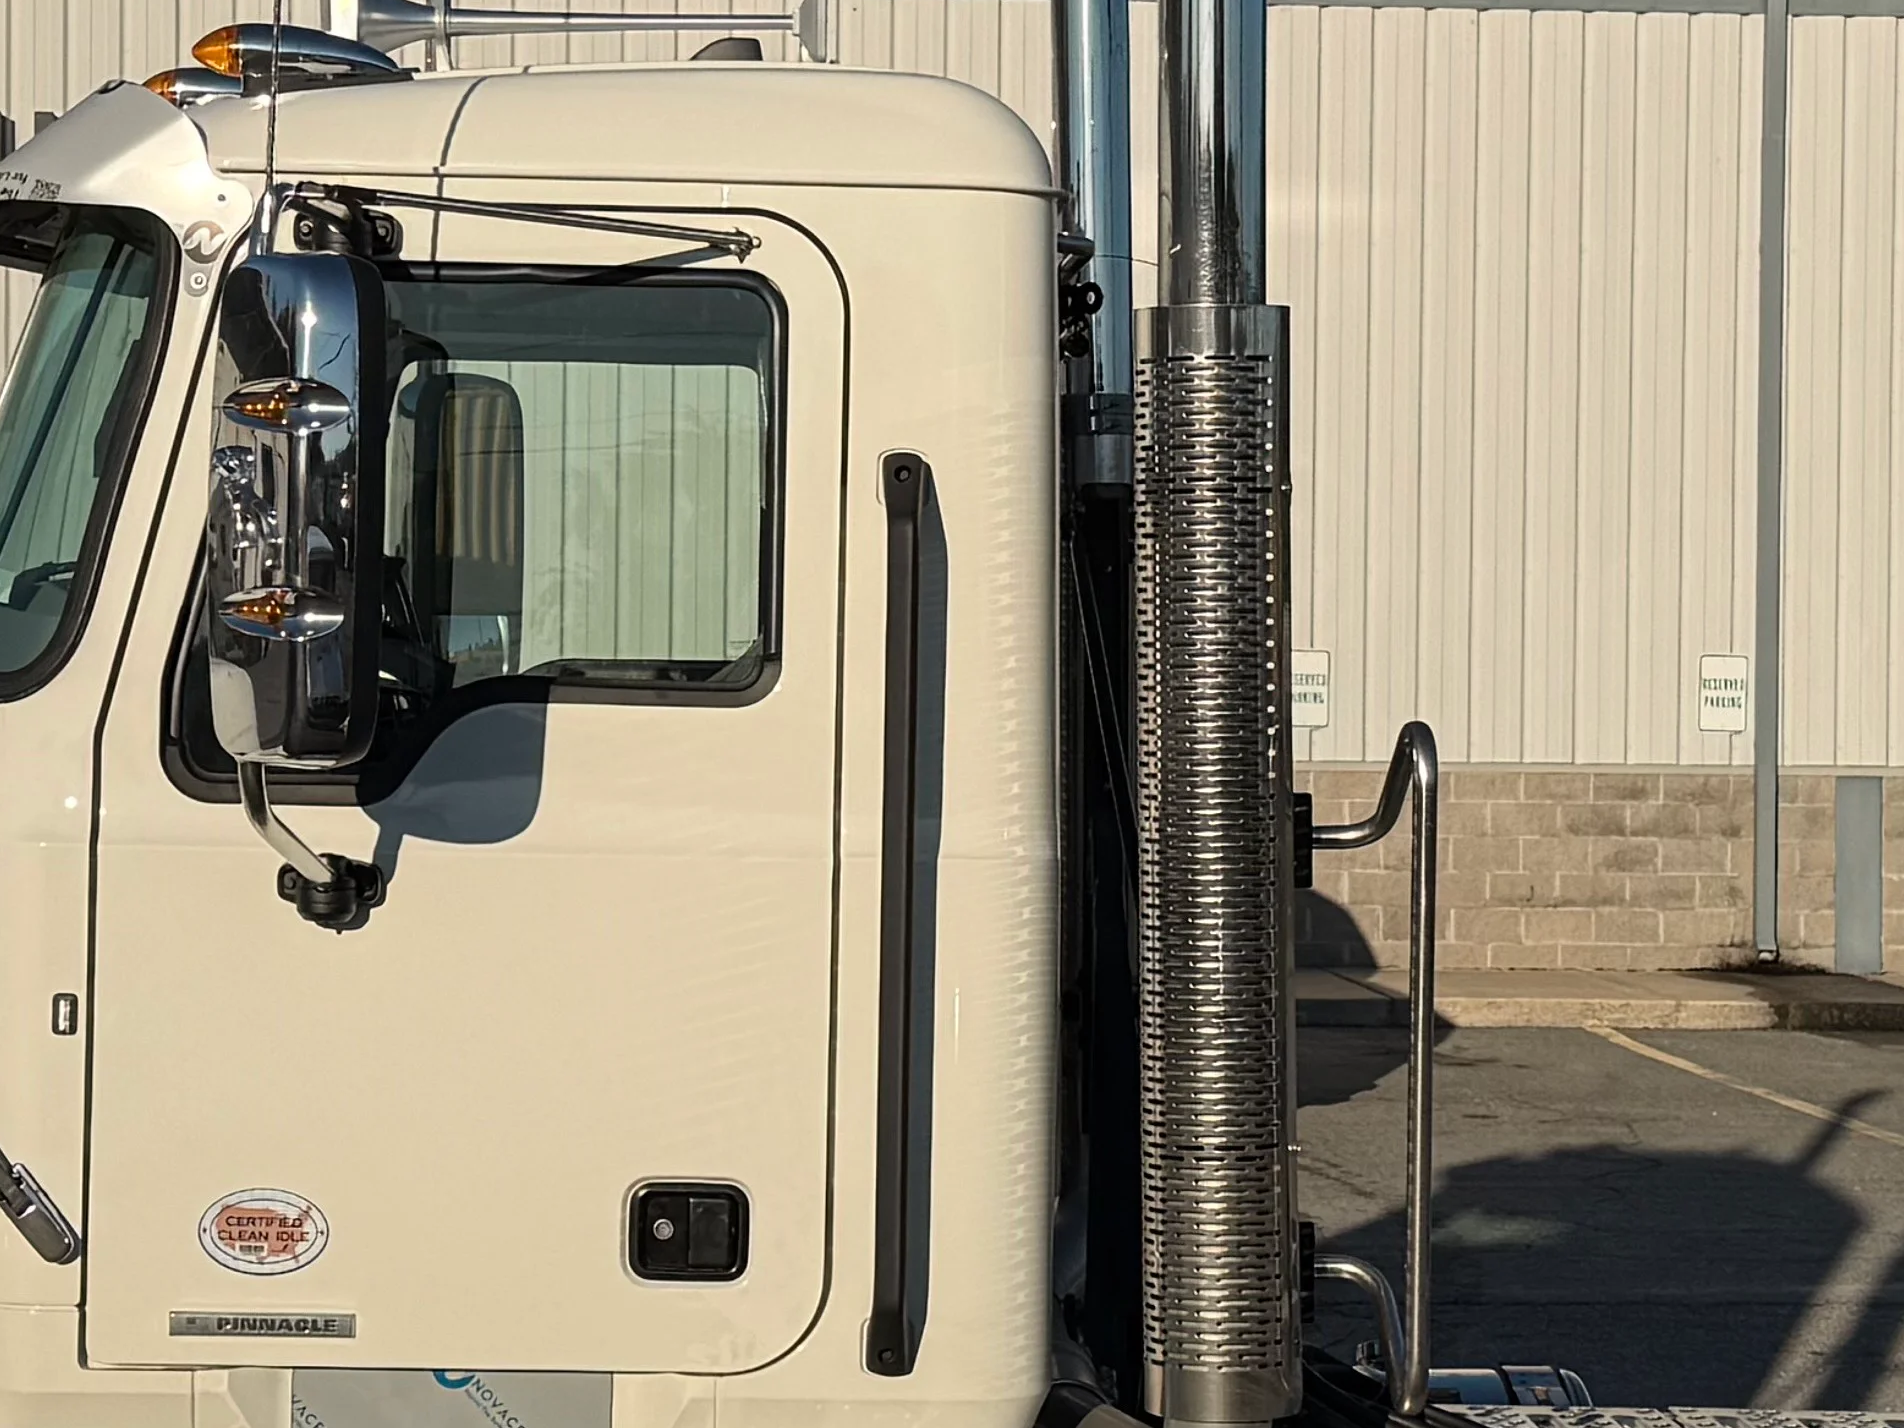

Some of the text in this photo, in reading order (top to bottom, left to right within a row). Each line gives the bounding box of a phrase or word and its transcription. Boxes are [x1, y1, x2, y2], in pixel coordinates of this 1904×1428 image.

[225, 1215, 303, 1228] CERTIFIED
[217, 1230, 310, 1242] CLEAN IDLE
[216, 1317, 338, 1332] PINNACLE
